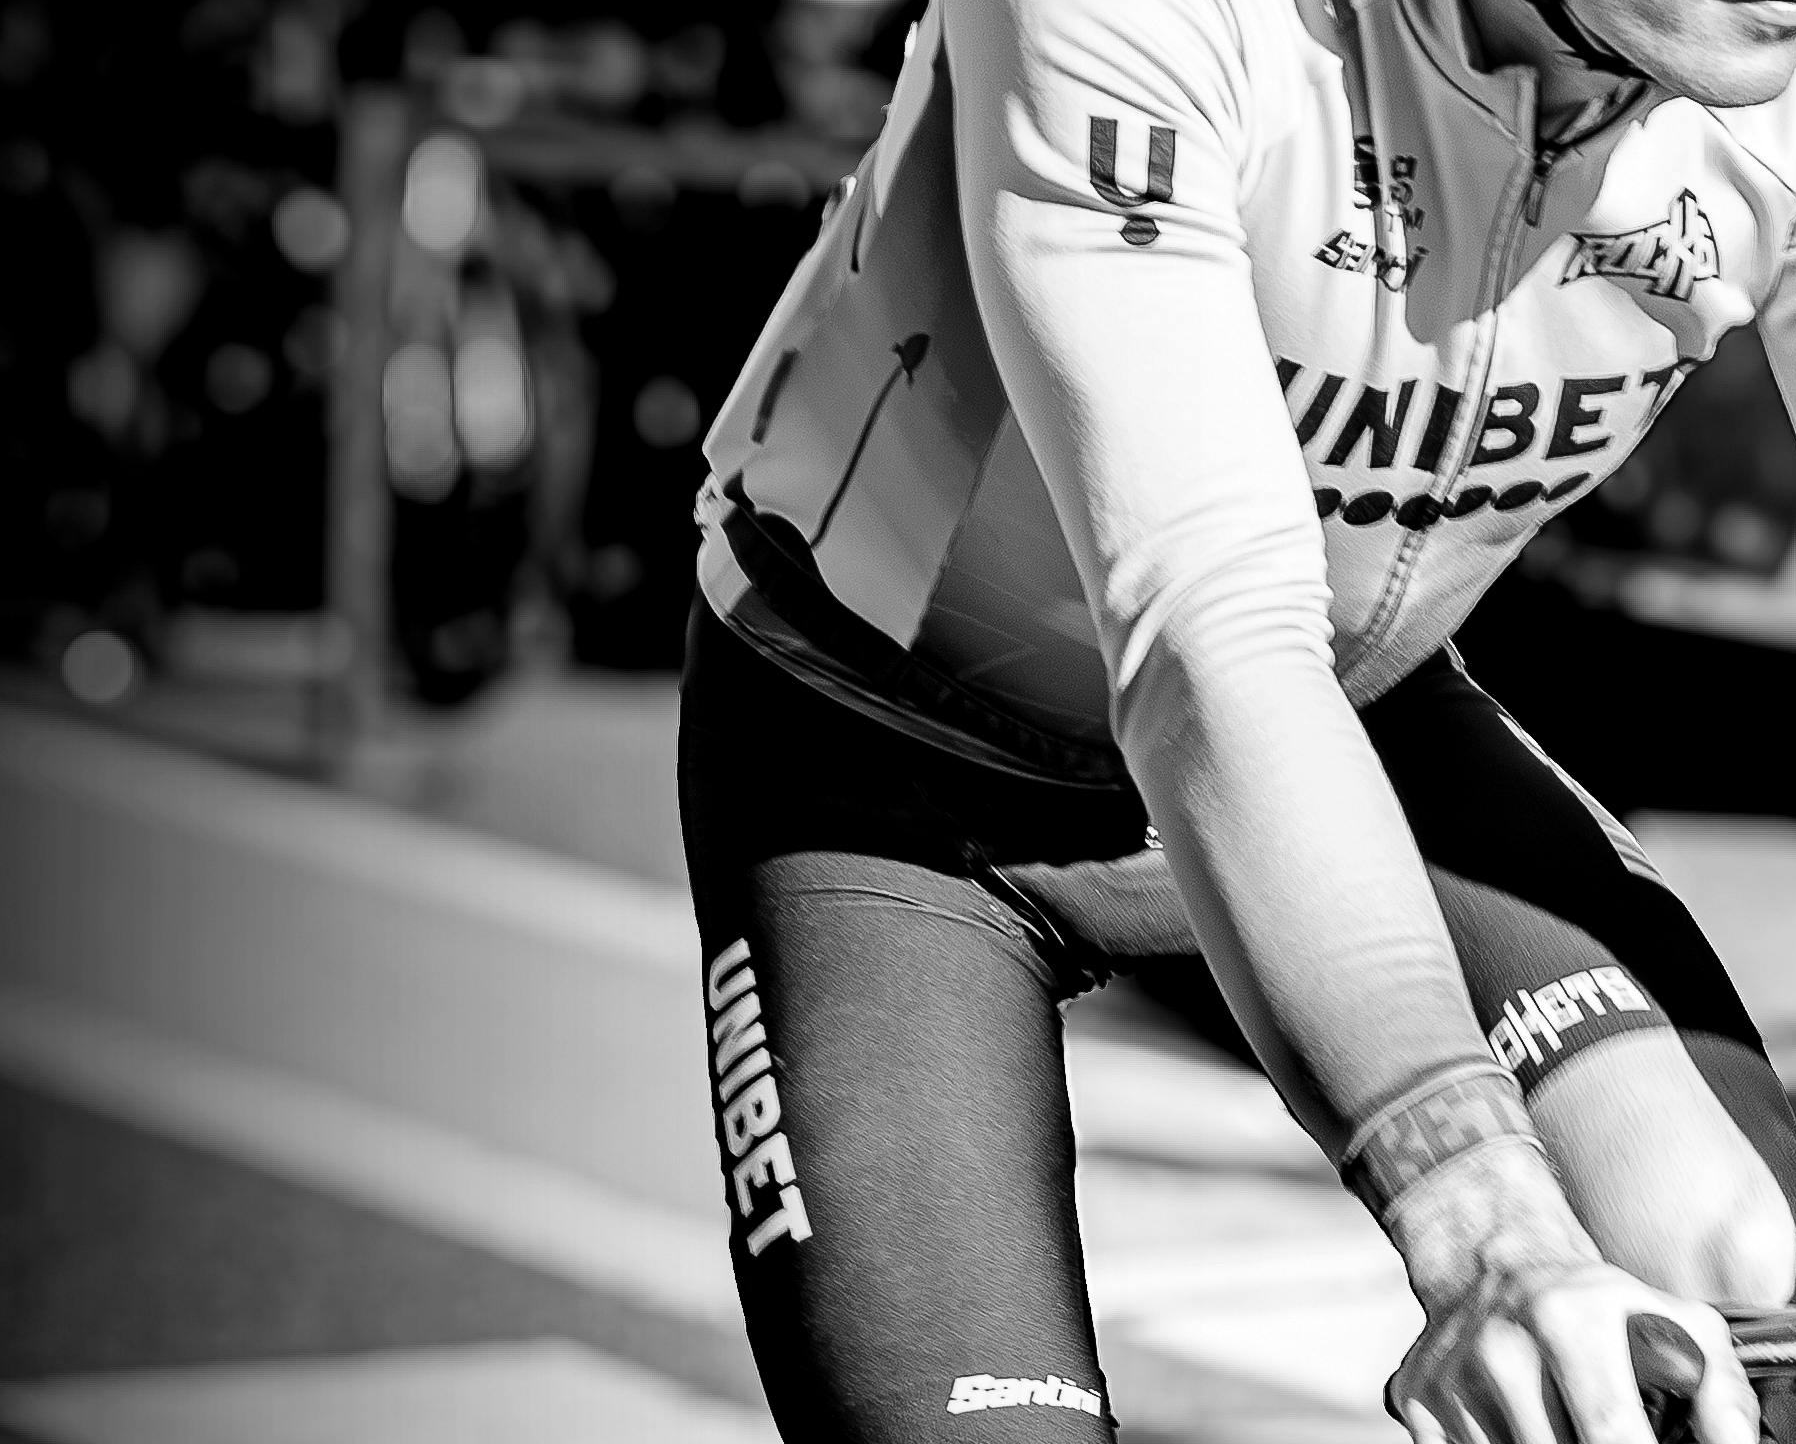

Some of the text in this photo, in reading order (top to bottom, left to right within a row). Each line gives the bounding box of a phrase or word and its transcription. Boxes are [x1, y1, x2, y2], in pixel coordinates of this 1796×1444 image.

[1090, 116, 1176, 208] U
[708, 937, 814, 1257] UNIBET
[946, 1373, 1102, 1417] Santini
